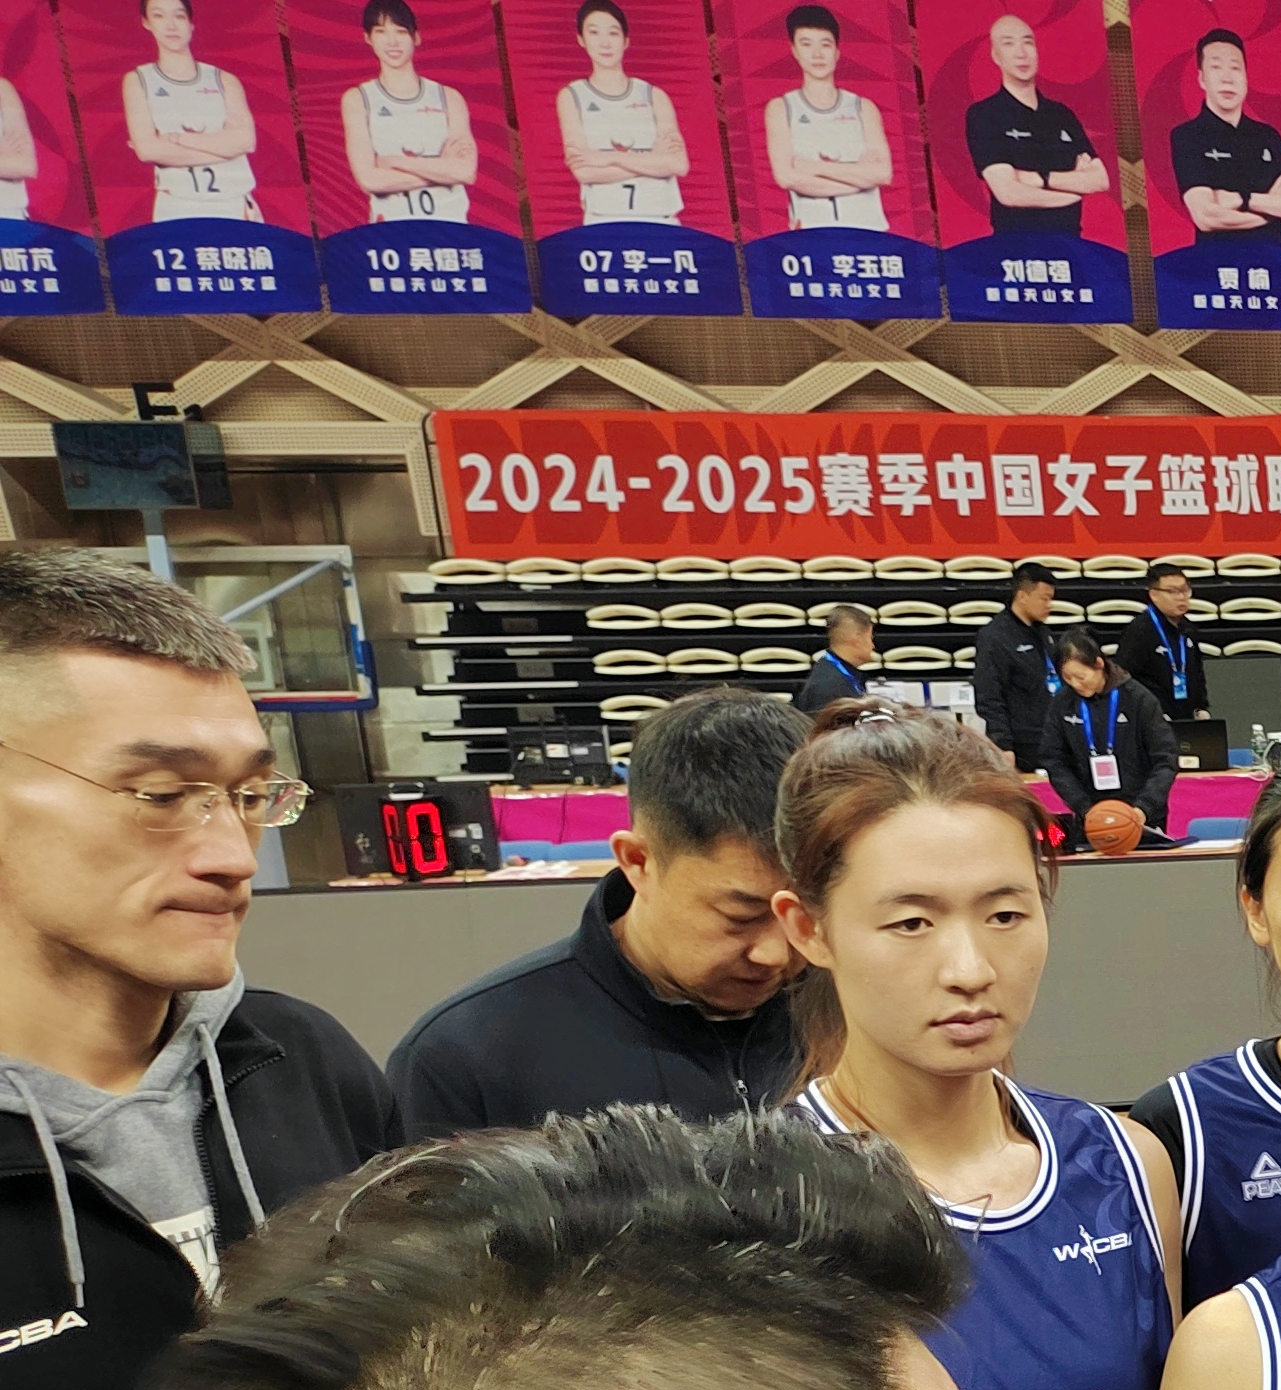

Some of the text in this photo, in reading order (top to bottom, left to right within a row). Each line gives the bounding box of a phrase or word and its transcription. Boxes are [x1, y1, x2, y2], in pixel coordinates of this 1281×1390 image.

[0, 247, 57, 272] 昕芃
[152, 248, 187, 271] 12
[366, 248, 400, 271] 10
[579, 249, 699, 274] 07 李一凡
[781, 254, 813, 277] 01
